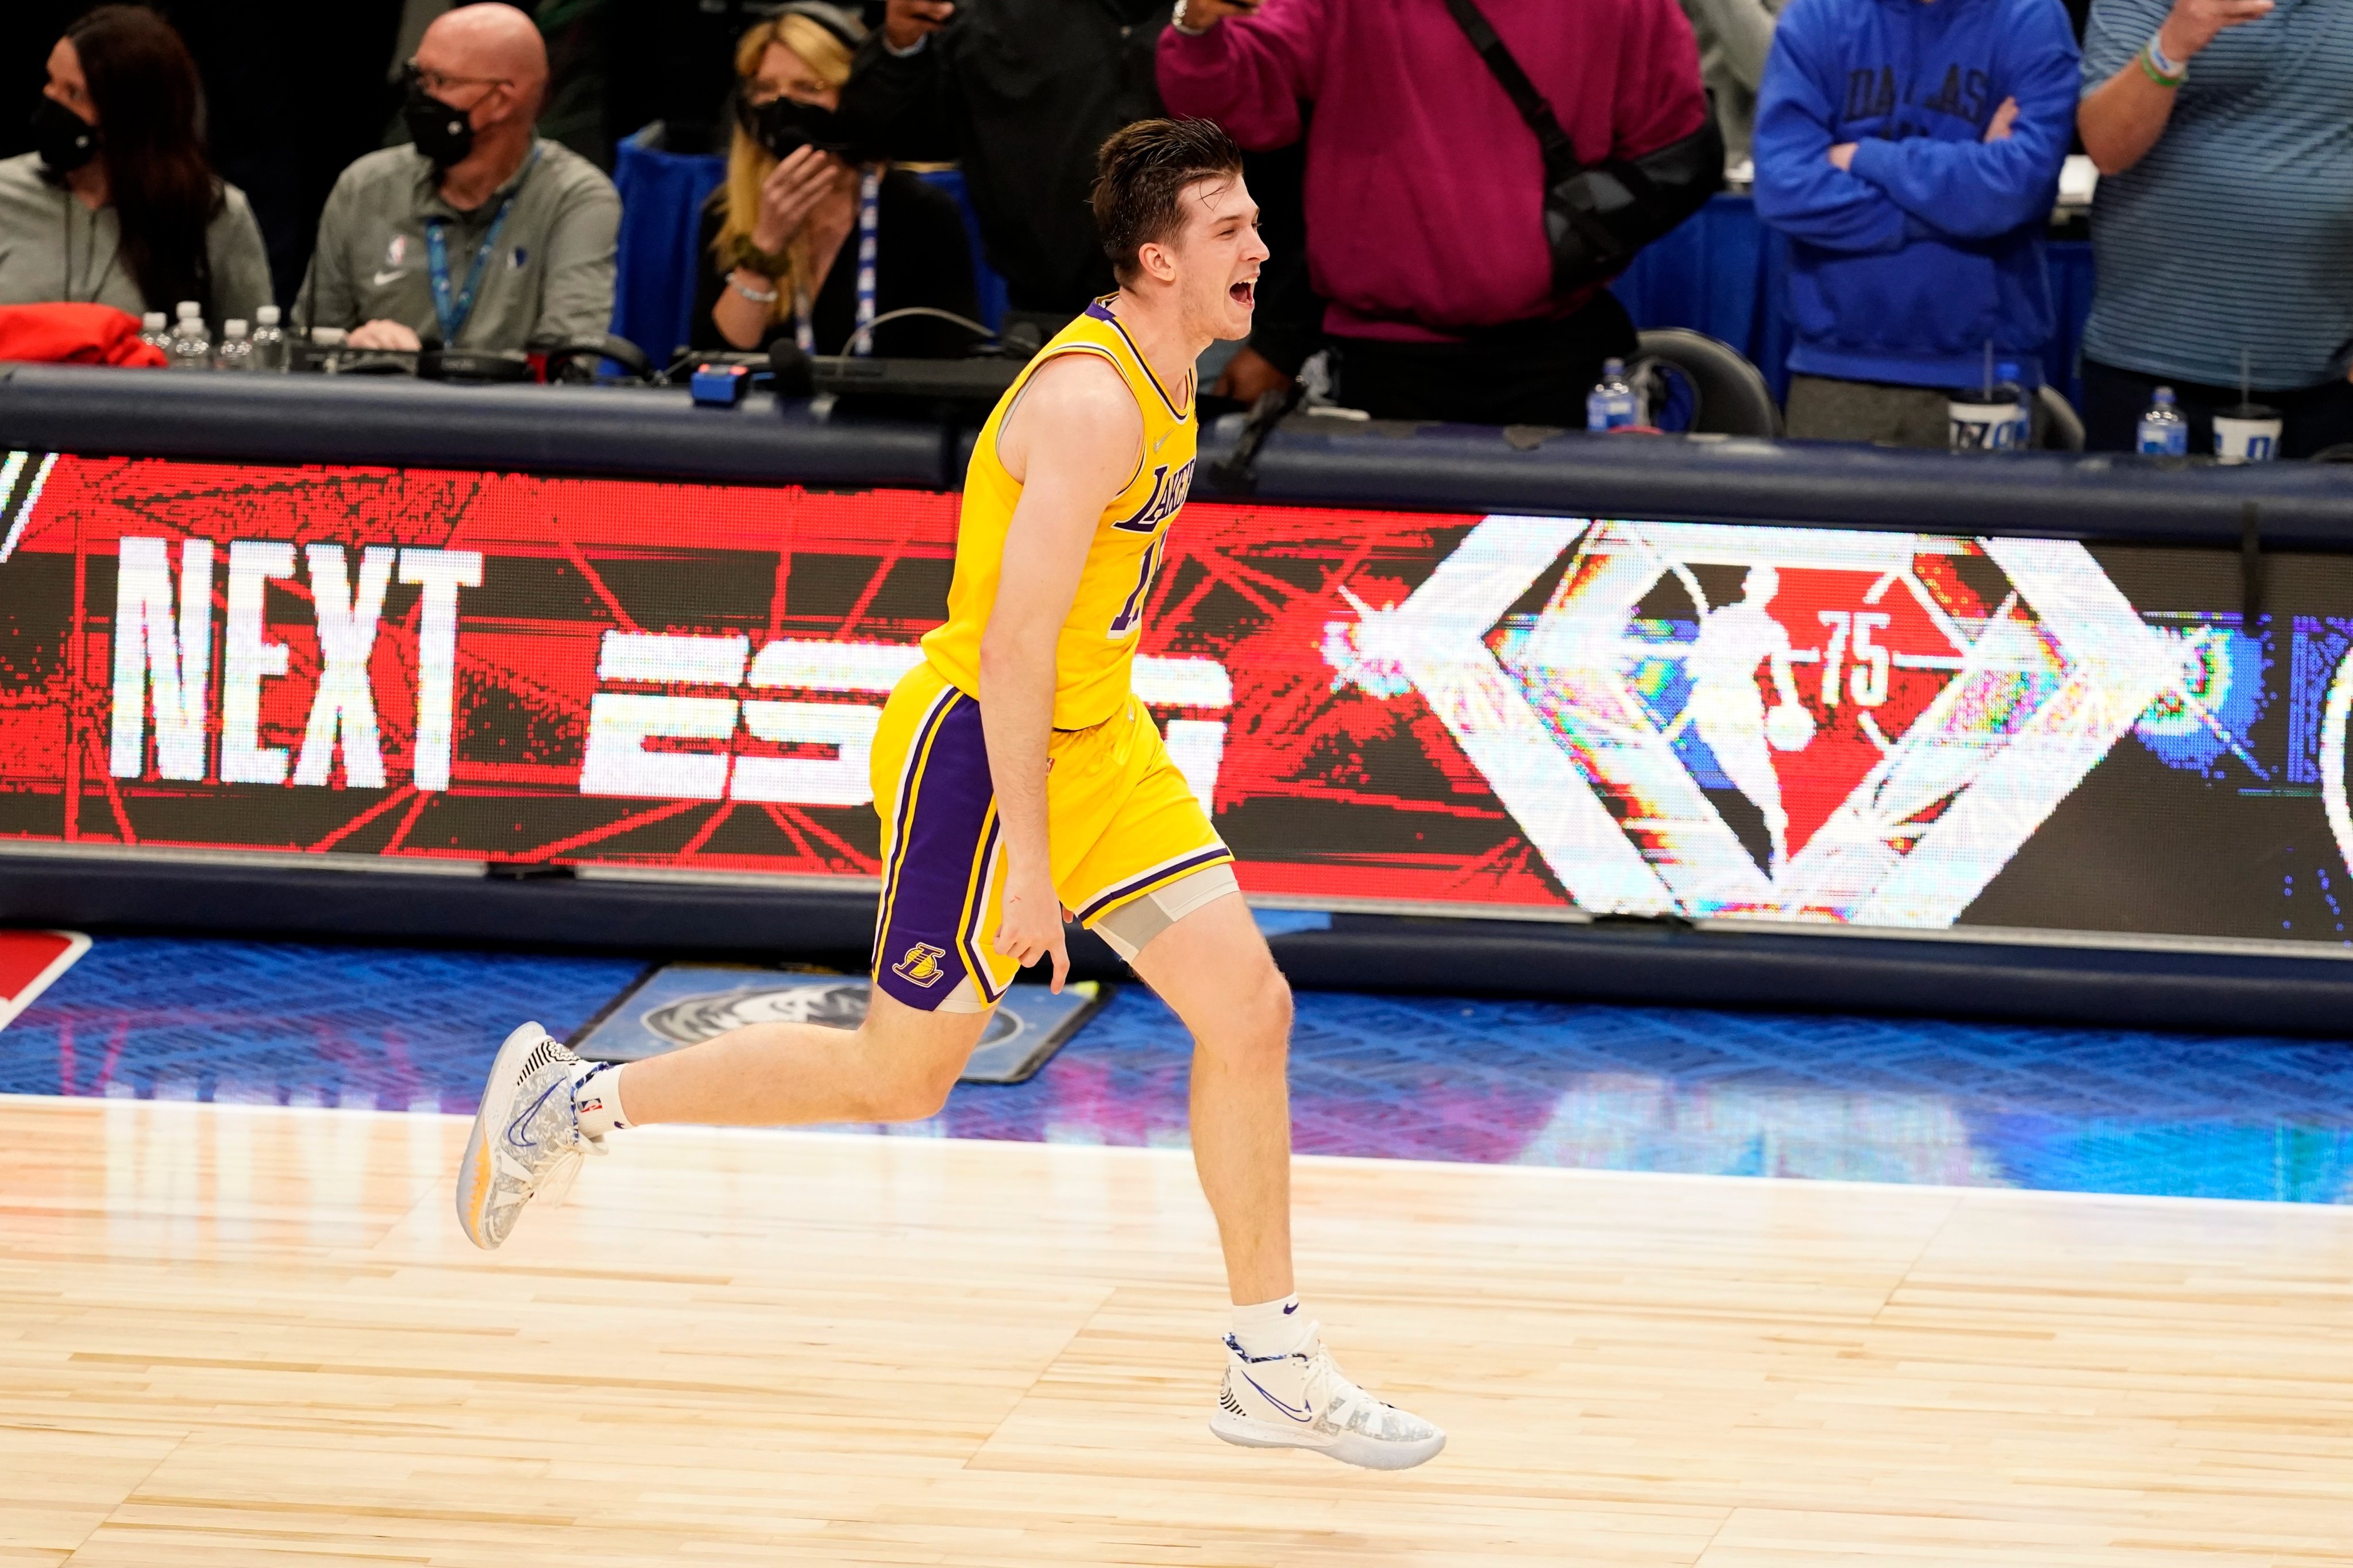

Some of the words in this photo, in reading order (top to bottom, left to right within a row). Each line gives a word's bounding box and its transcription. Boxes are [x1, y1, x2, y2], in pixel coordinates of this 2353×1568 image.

[1106, 527, 1170, 640] 1
[1818, 610, 1891, 708] 75
[110, 535, 483, 791] NEXT
[580, 628, 1233, 822] ES
